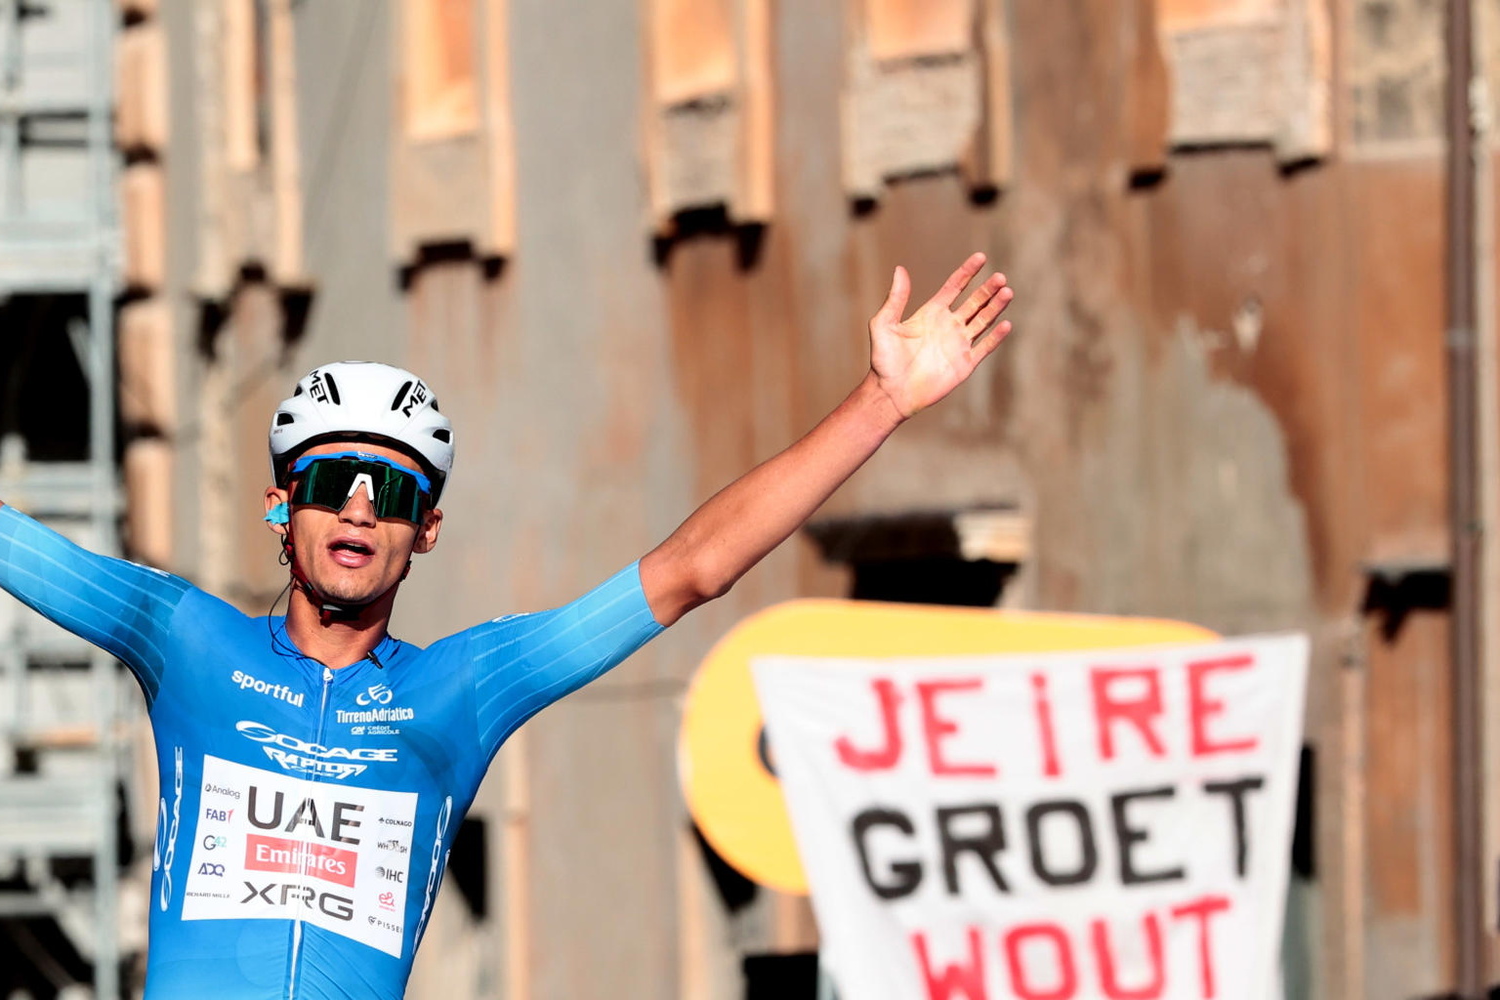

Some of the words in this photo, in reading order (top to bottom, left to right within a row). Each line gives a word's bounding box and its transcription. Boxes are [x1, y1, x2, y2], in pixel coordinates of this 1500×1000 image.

[309, 370, 329, 404] MET
[402, 380, 427, 417] MET
[231, 670, 304, 708] sportful
[336, 707, 414, 723] TirrenoAdriatico
[235, 720, 399, 762] SOCAGE
[211, 785, 241, 799] Analog
[205, 808, 227, 822] FAB
[247, 785, 365, 845] UAE
[384, 817, 413, 827] COLNAGO
[202, 834, 228, 851] G42
[851, 774, 1266, 901] GROET
[197, 862, 226, 877] ADQ
[255, 844, 347, 876] Emirates
[385, 869, 404, 883] IHC
[239, 881, 355, 922] XRG
